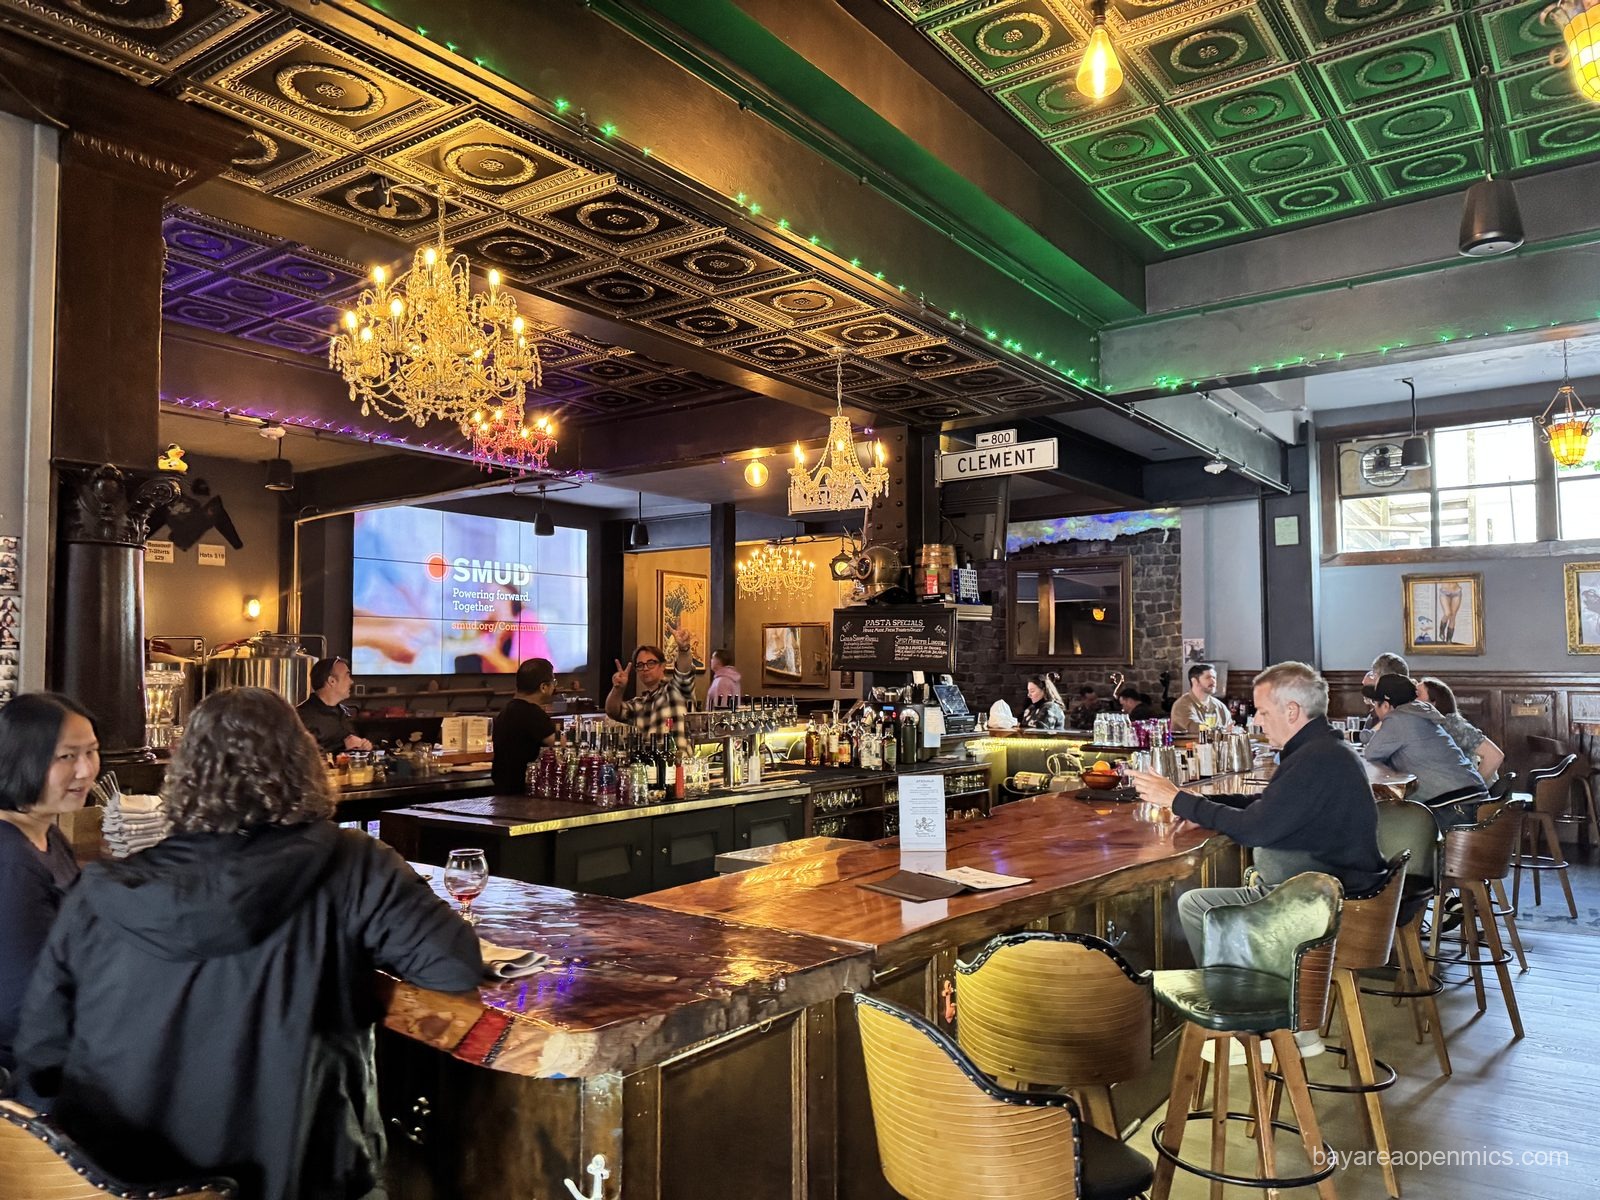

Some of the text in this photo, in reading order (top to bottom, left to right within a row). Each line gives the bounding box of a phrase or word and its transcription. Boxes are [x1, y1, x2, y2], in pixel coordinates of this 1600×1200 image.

[991, 432, 1011, 445] 800
[957, 447, 1036, 473] CLEMENT
[453, 557, 530, 586] SMUD
[452, 587, 531, 602] Powering forward.
[452, 600, 495, 613] Together.
[865, 619, 924, 627] PASTA SPECIALS
